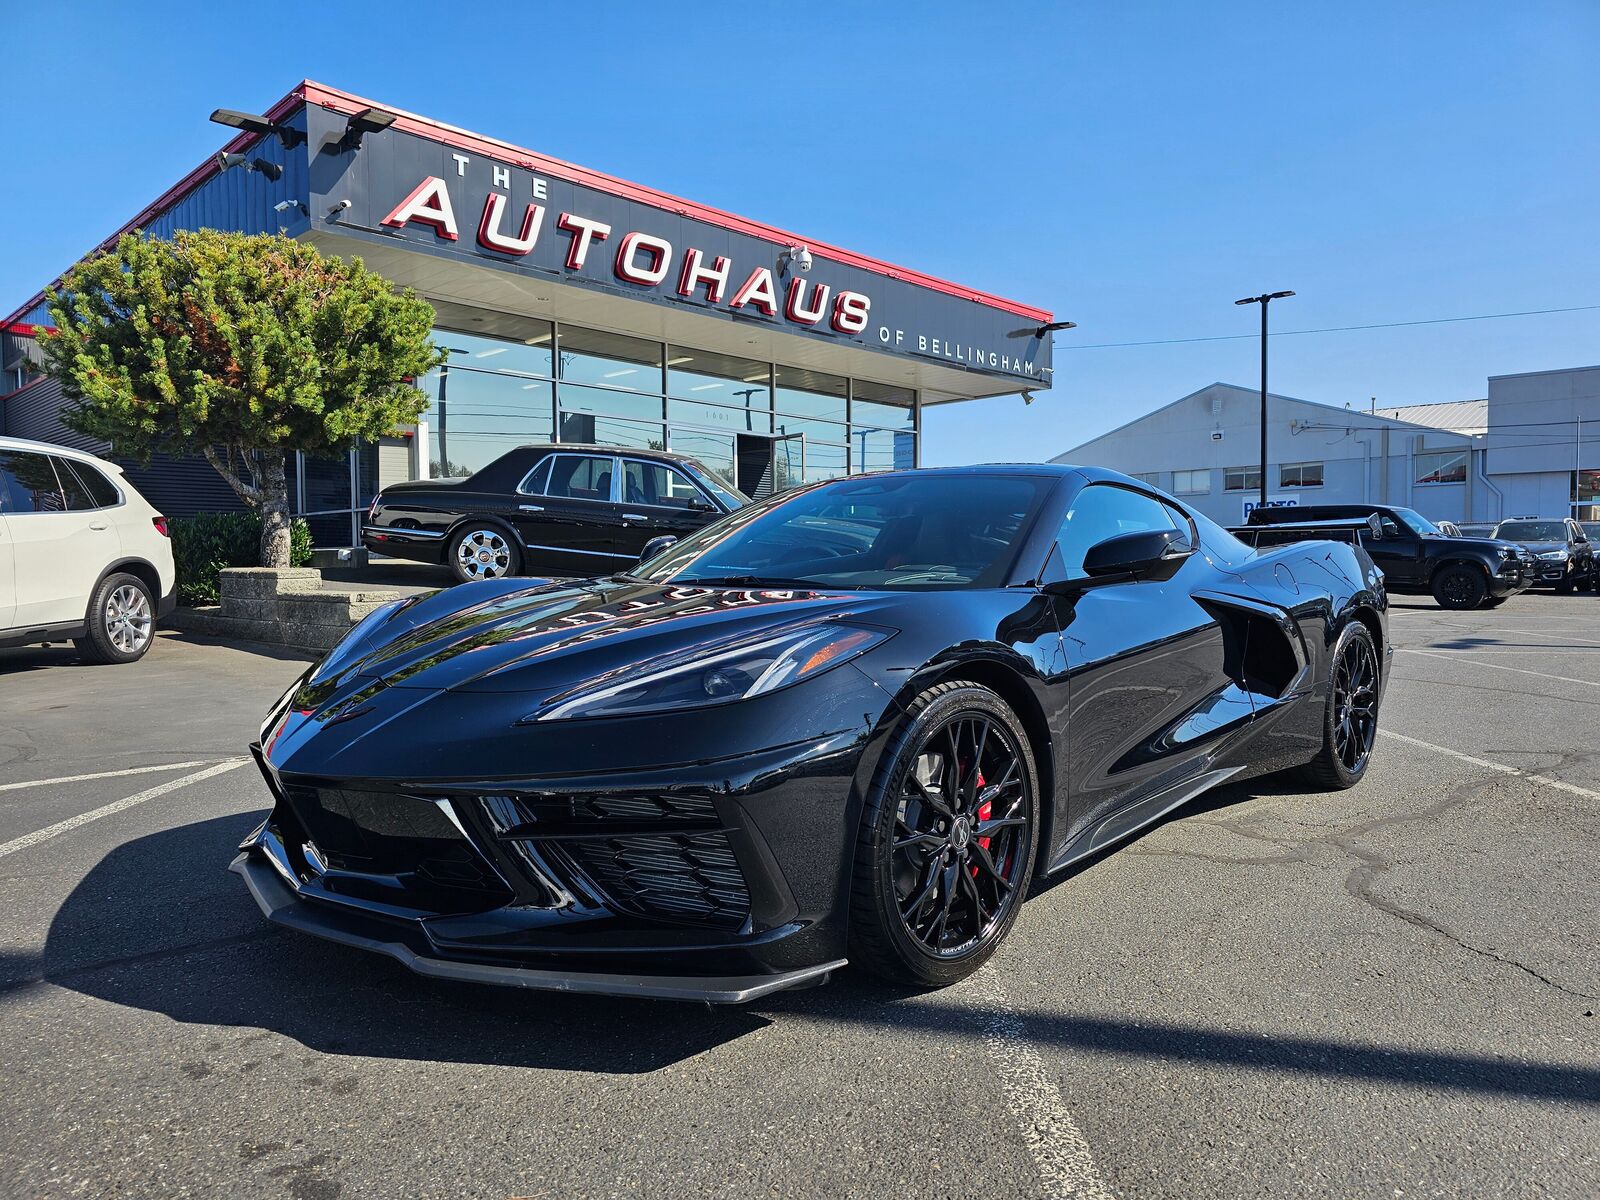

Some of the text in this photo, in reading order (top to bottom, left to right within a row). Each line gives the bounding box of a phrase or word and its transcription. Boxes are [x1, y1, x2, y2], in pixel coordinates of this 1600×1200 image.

[452, 153, 547, 200] THE
[380, 176, 871, 335] AUTOHAUS
[879, 327, 1033, 375] OF BELLINGHAM
